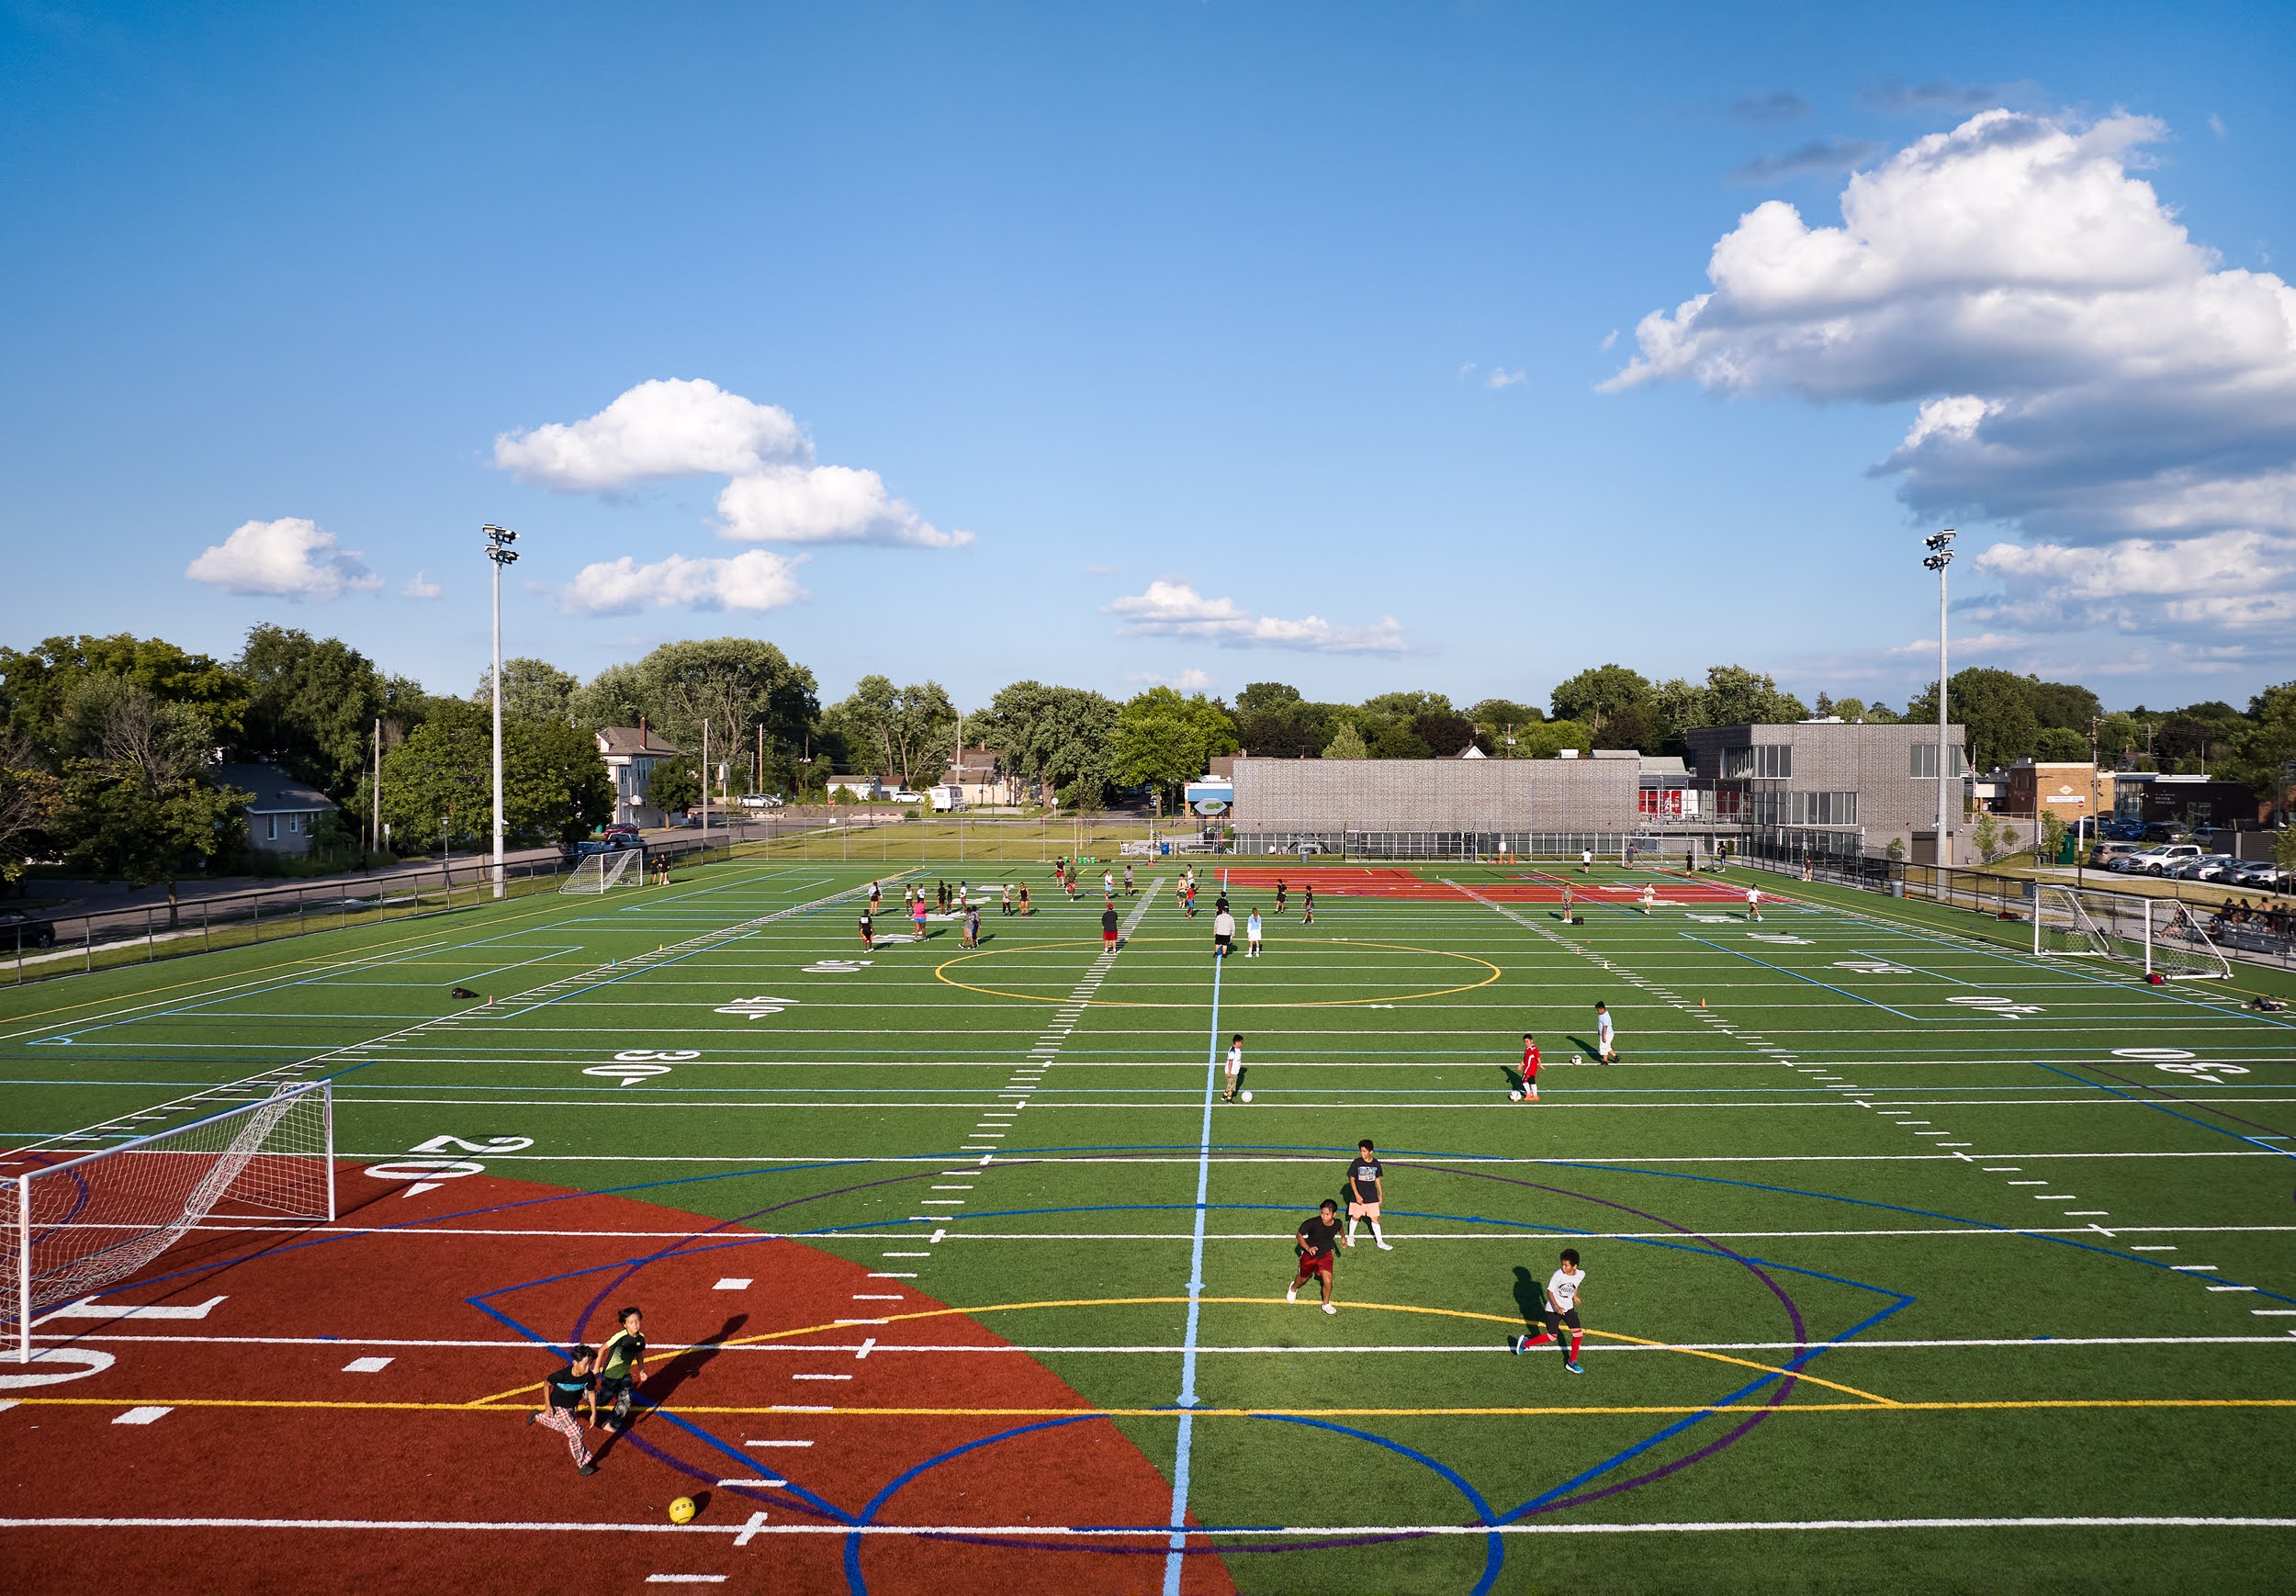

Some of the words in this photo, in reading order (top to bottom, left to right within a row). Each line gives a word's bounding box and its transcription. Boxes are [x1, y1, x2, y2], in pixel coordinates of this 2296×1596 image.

[801, 960, 875, 973] 50
[1832, 961, 1913, 975] 50
[714, 995, 800, 1014] 40
[1945, 996, 2047, 1014] 40
[582, 1050, 702, 1077] 30
[2110, 1048, 2250, 1075] 30
[364, 1134, 535, 1180] 20
